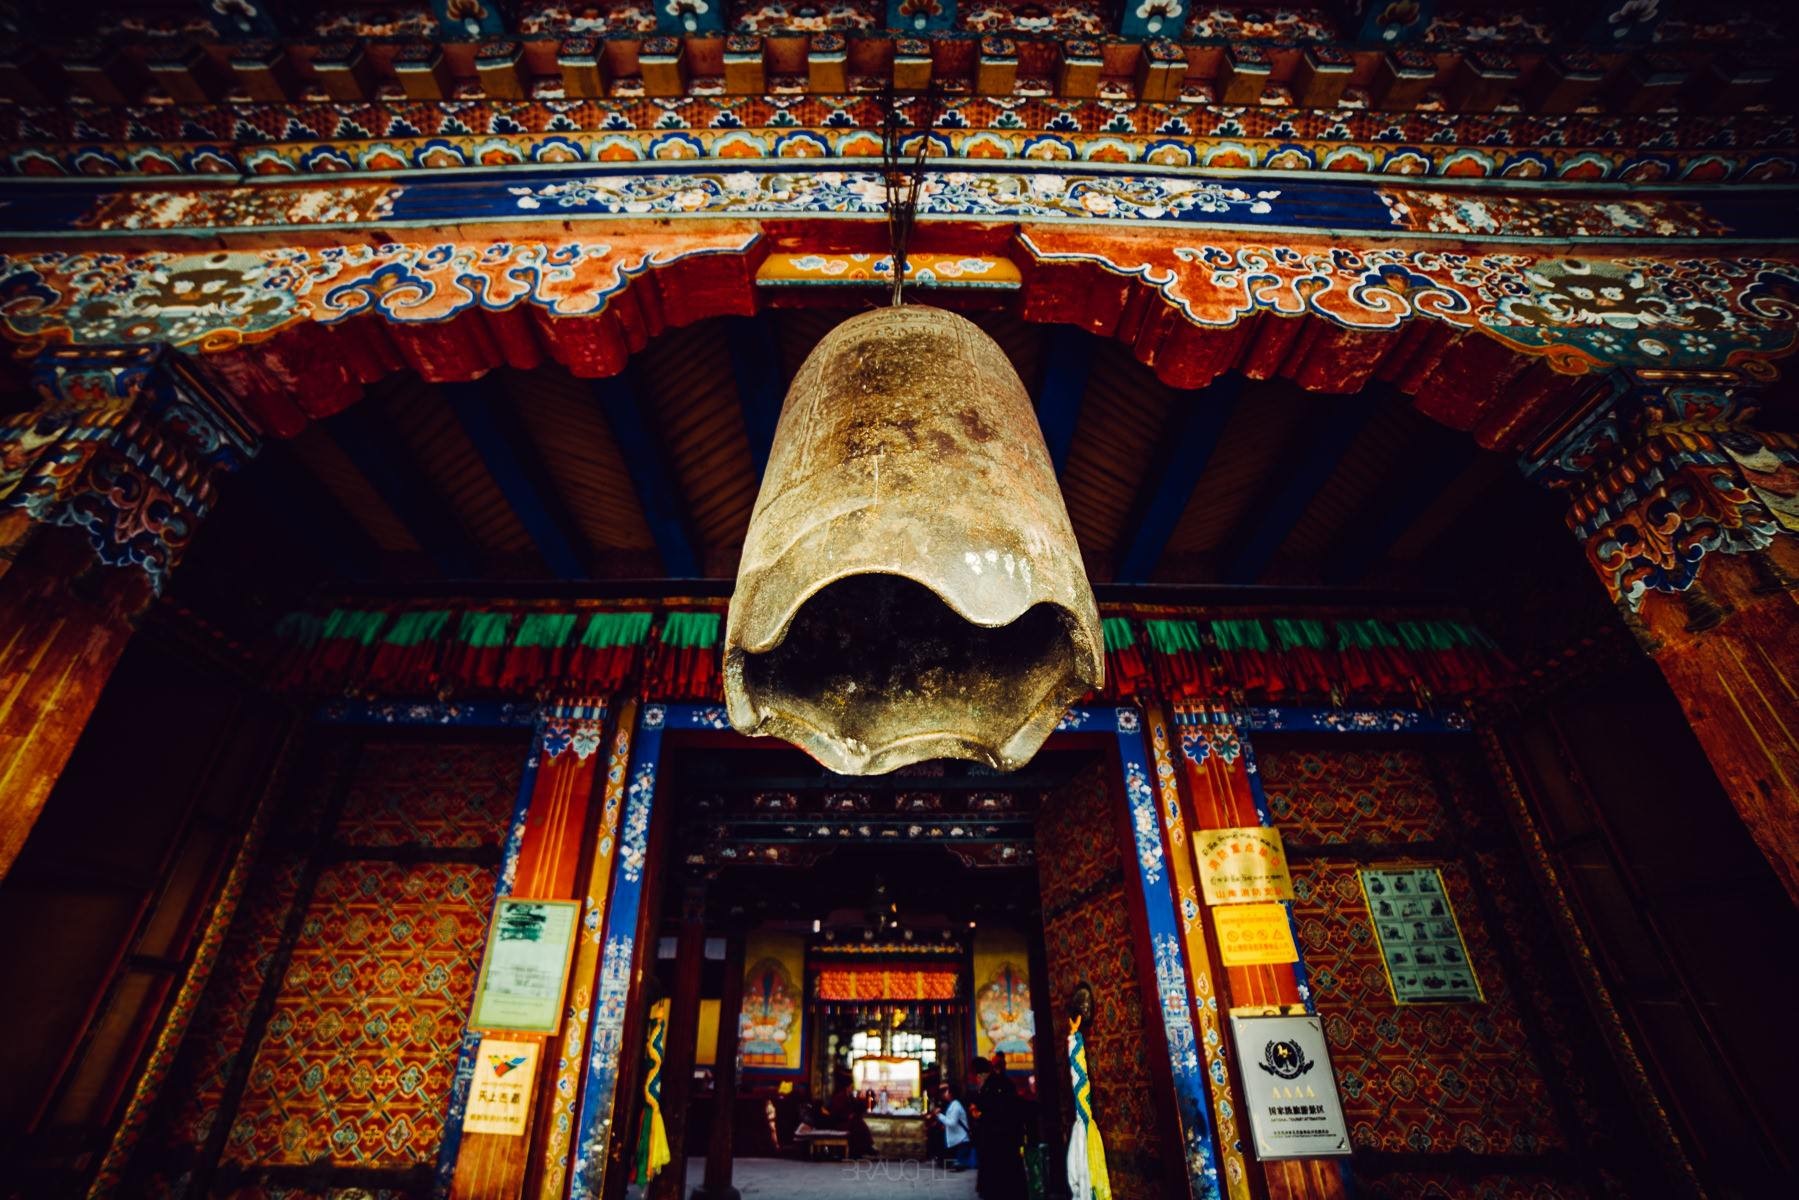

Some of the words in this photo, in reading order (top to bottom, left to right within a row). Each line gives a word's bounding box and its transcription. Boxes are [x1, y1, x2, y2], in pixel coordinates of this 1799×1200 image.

[1271, 1085, 1316, 1099] AAAA
[1268, 1104, 1325, 1116] 国家级旅游景区
